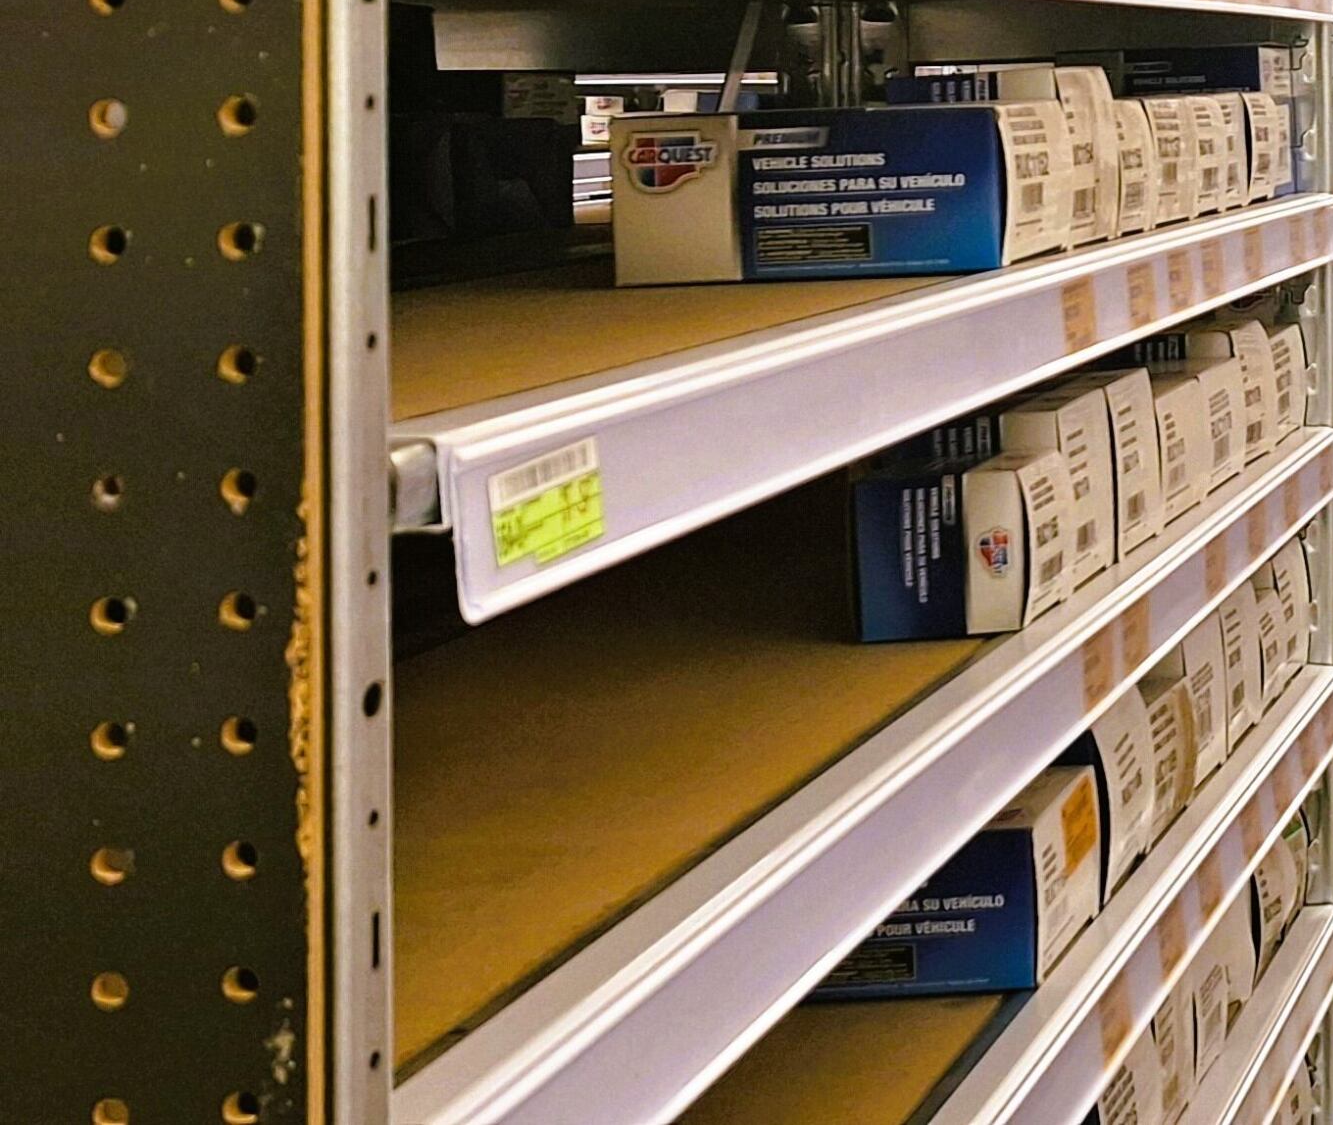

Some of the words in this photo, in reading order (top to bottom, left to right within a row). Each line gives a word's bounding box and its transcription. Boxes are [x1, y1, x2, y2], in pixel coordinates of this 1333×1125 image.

[629, 146, 713, 164] CARQUEST
[752, 155, 809, 171] VEHICLE
[811, 152, 886, 168] SOLUTIONS
[753, 179, 837, 195] SOLUCIONES
[839, 178, 876, 192] PARA
[878, 176, 897, 190] SU
[754, 203, 829, 219] SOLUTIONS
[831, 202, 869, 216] POUR
[923, 896, 941, 910] SU
[877, 923, 913, 937] POUR
